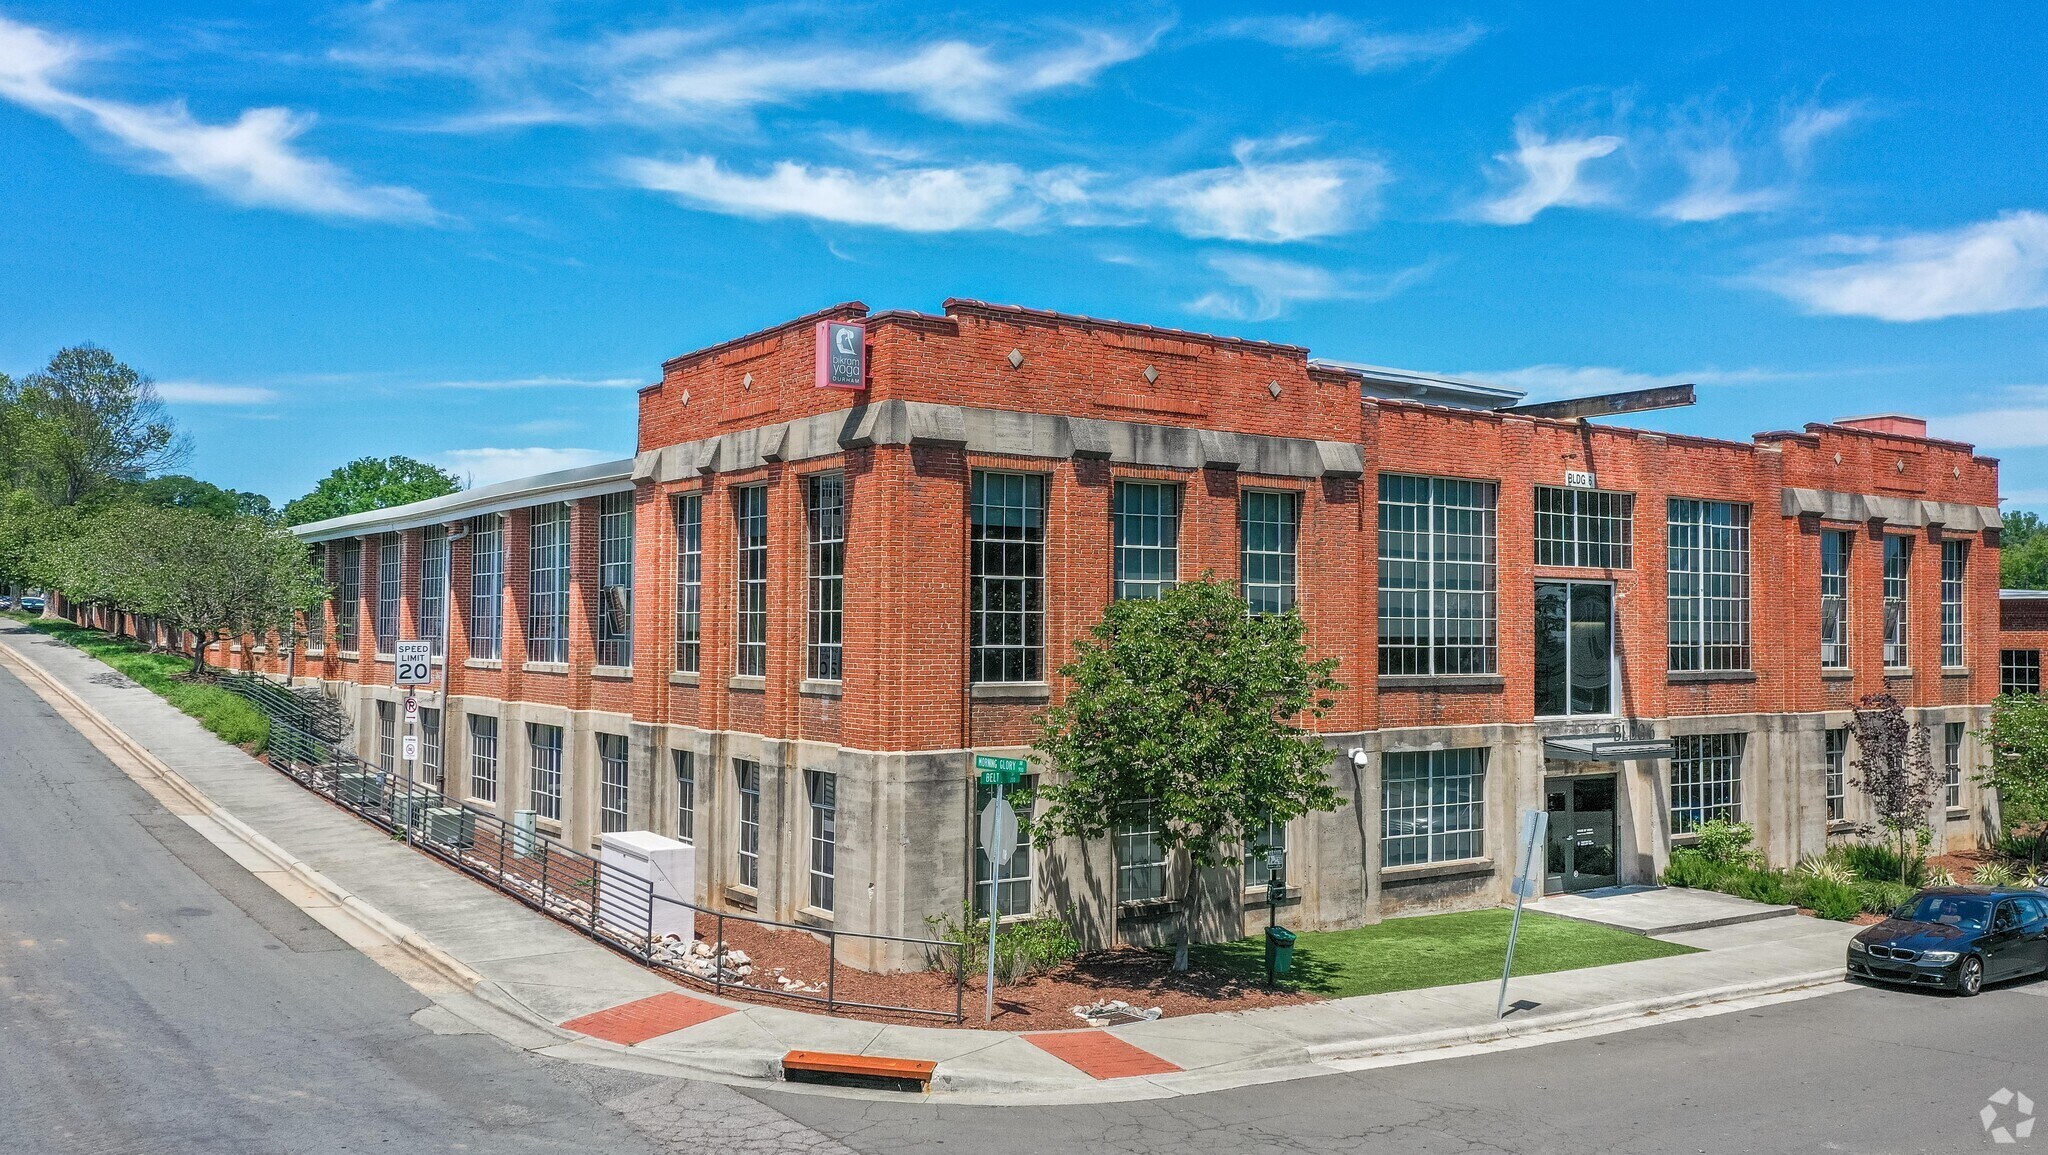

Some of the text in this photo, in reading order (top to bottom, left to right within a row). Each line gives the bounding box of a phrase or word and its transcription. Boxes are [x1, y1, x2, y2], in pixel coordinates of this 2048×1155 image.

[832, 354, 860, 366] bikram
[833, 364, 860, 377] yoga
[1568, 473, 1593, 486] BLDG 6
[399, 645, 429, 653] SPEED
[398, 663, 428, 679] 20
[1613, 723, 1655, 742] BLDG 6
[978, 757, 998, 769] MORNING
[999, 759, 1017, 770] GLORY
[985, 772, 1000, 783] BELT
